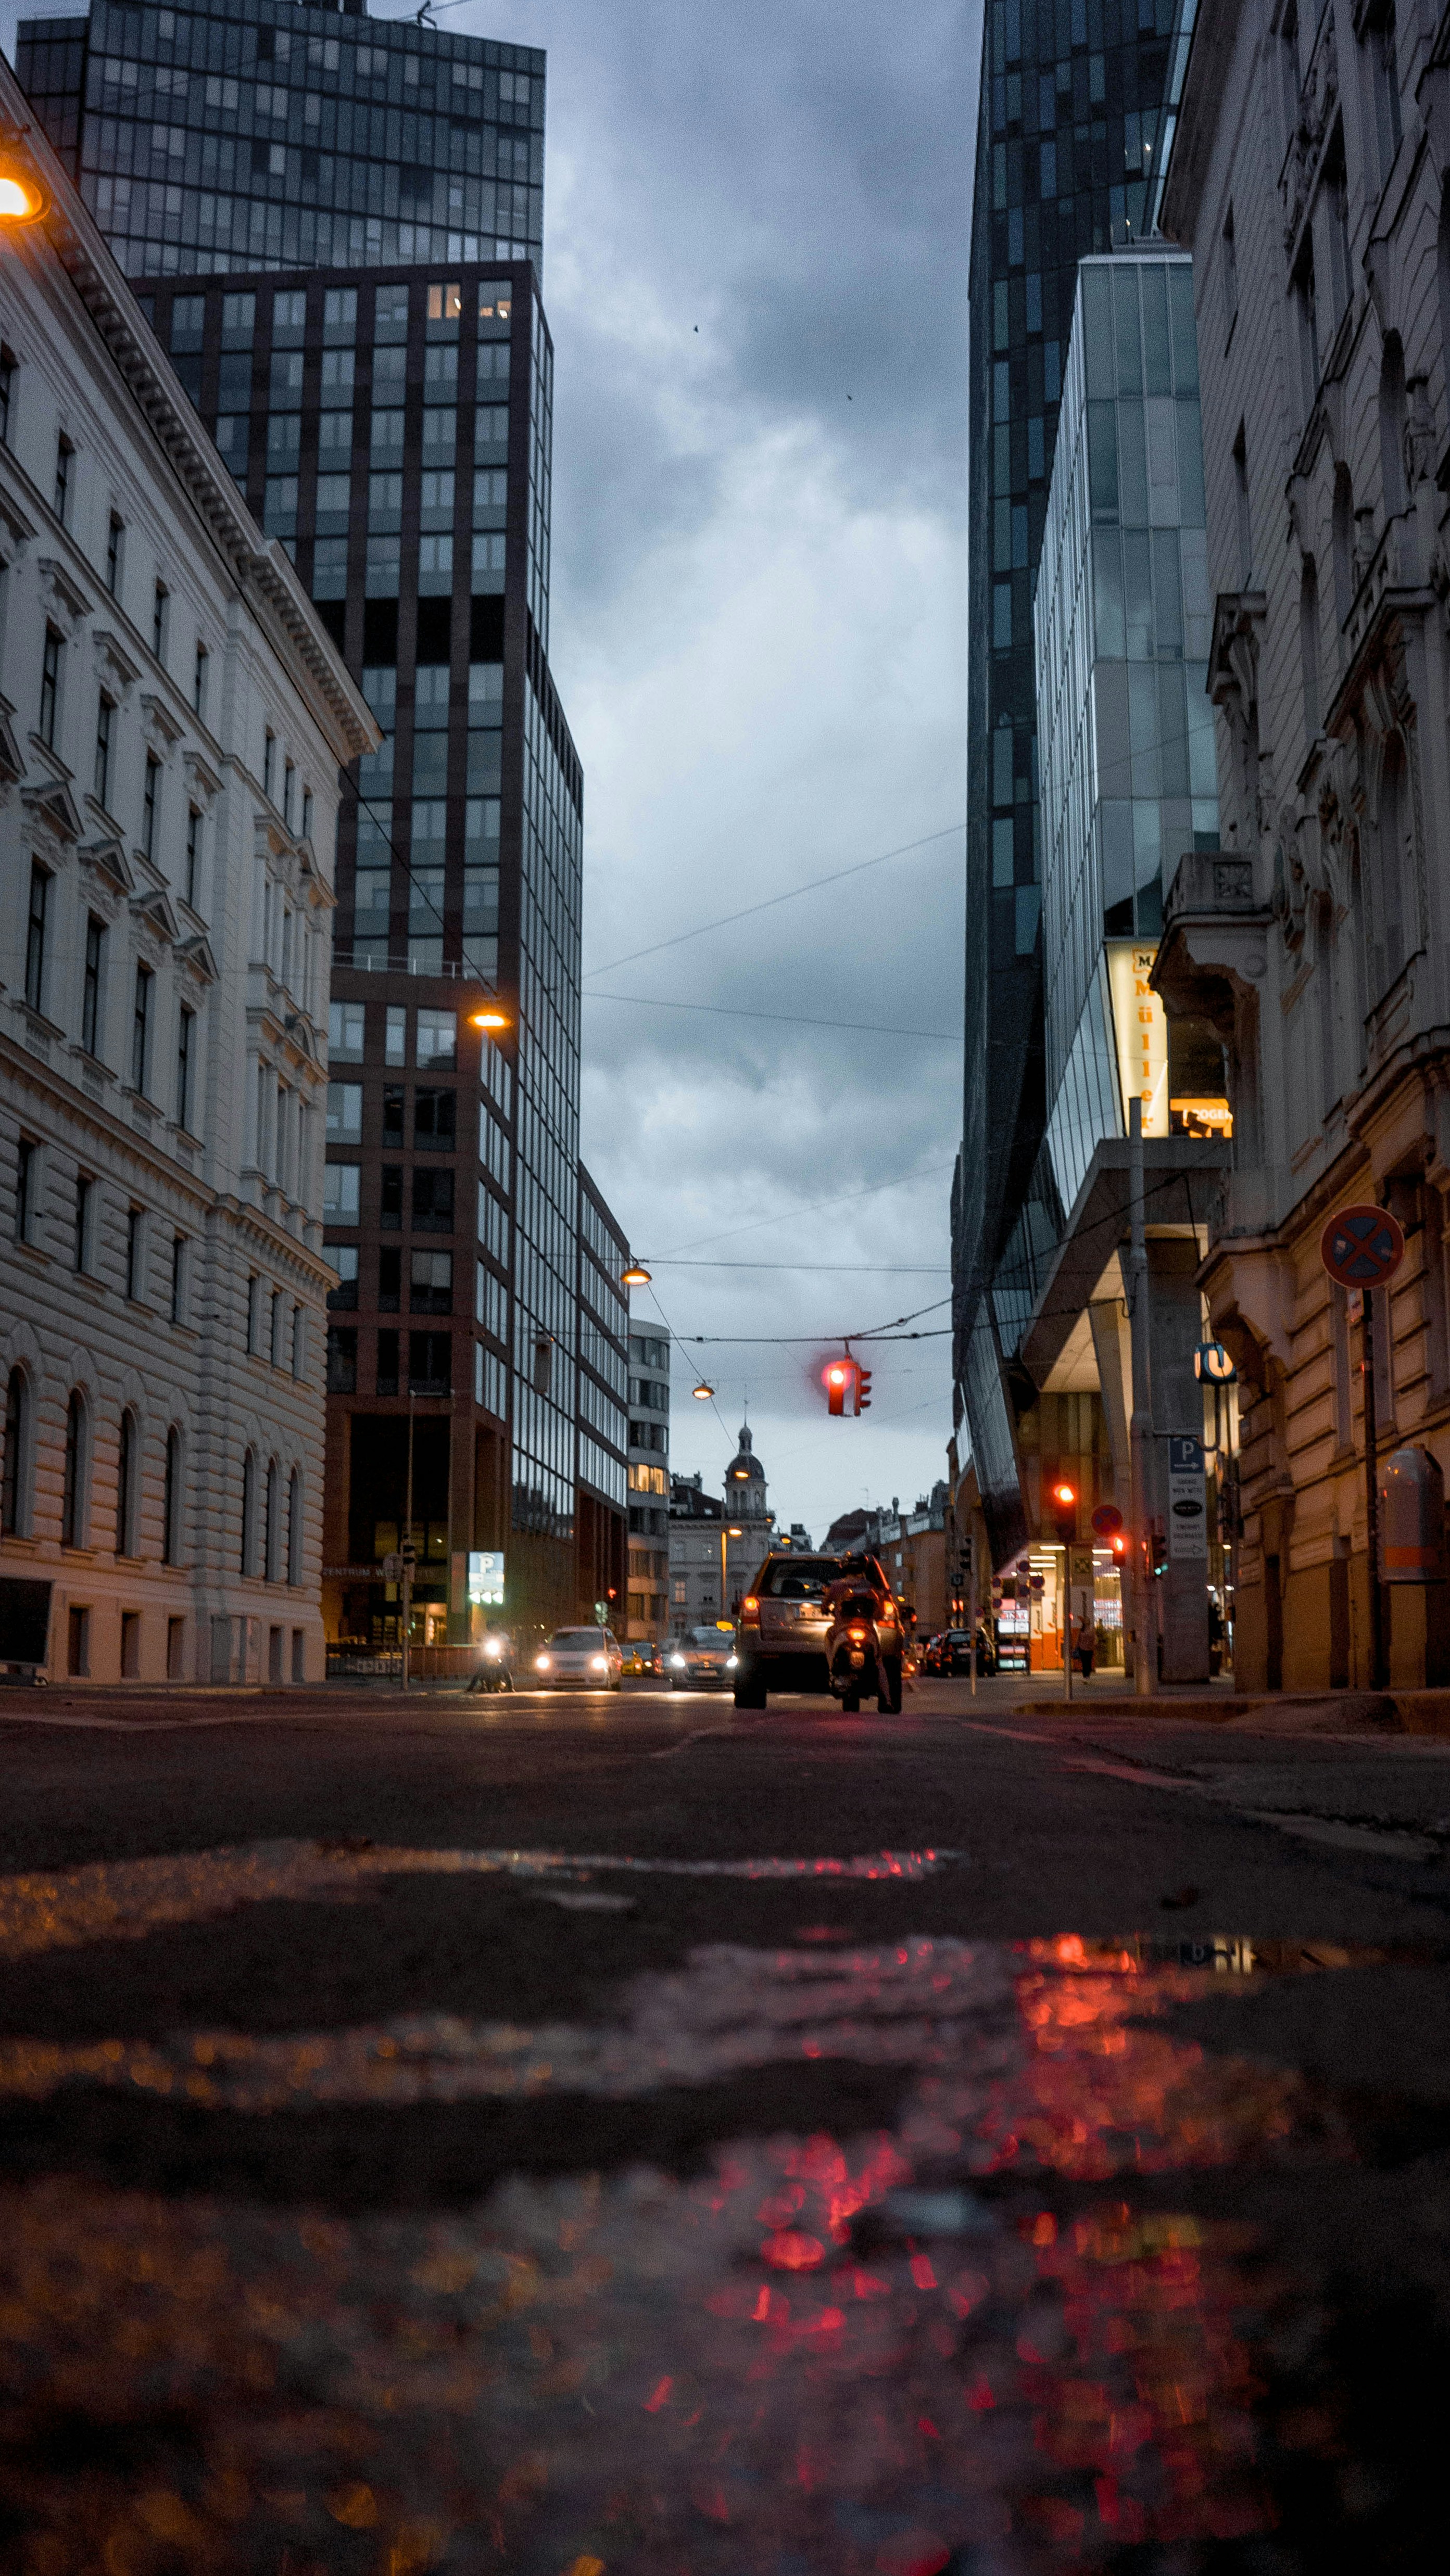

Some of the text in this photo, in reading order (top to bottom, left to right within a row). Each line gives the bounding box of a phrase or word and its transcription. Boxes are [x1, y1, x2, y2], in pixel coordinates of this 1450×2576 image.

[1135, 980, 1155, 1129] Müller
[1182, 1441, 1194, 1461] P
[480, 1557, 494, 1575] P
